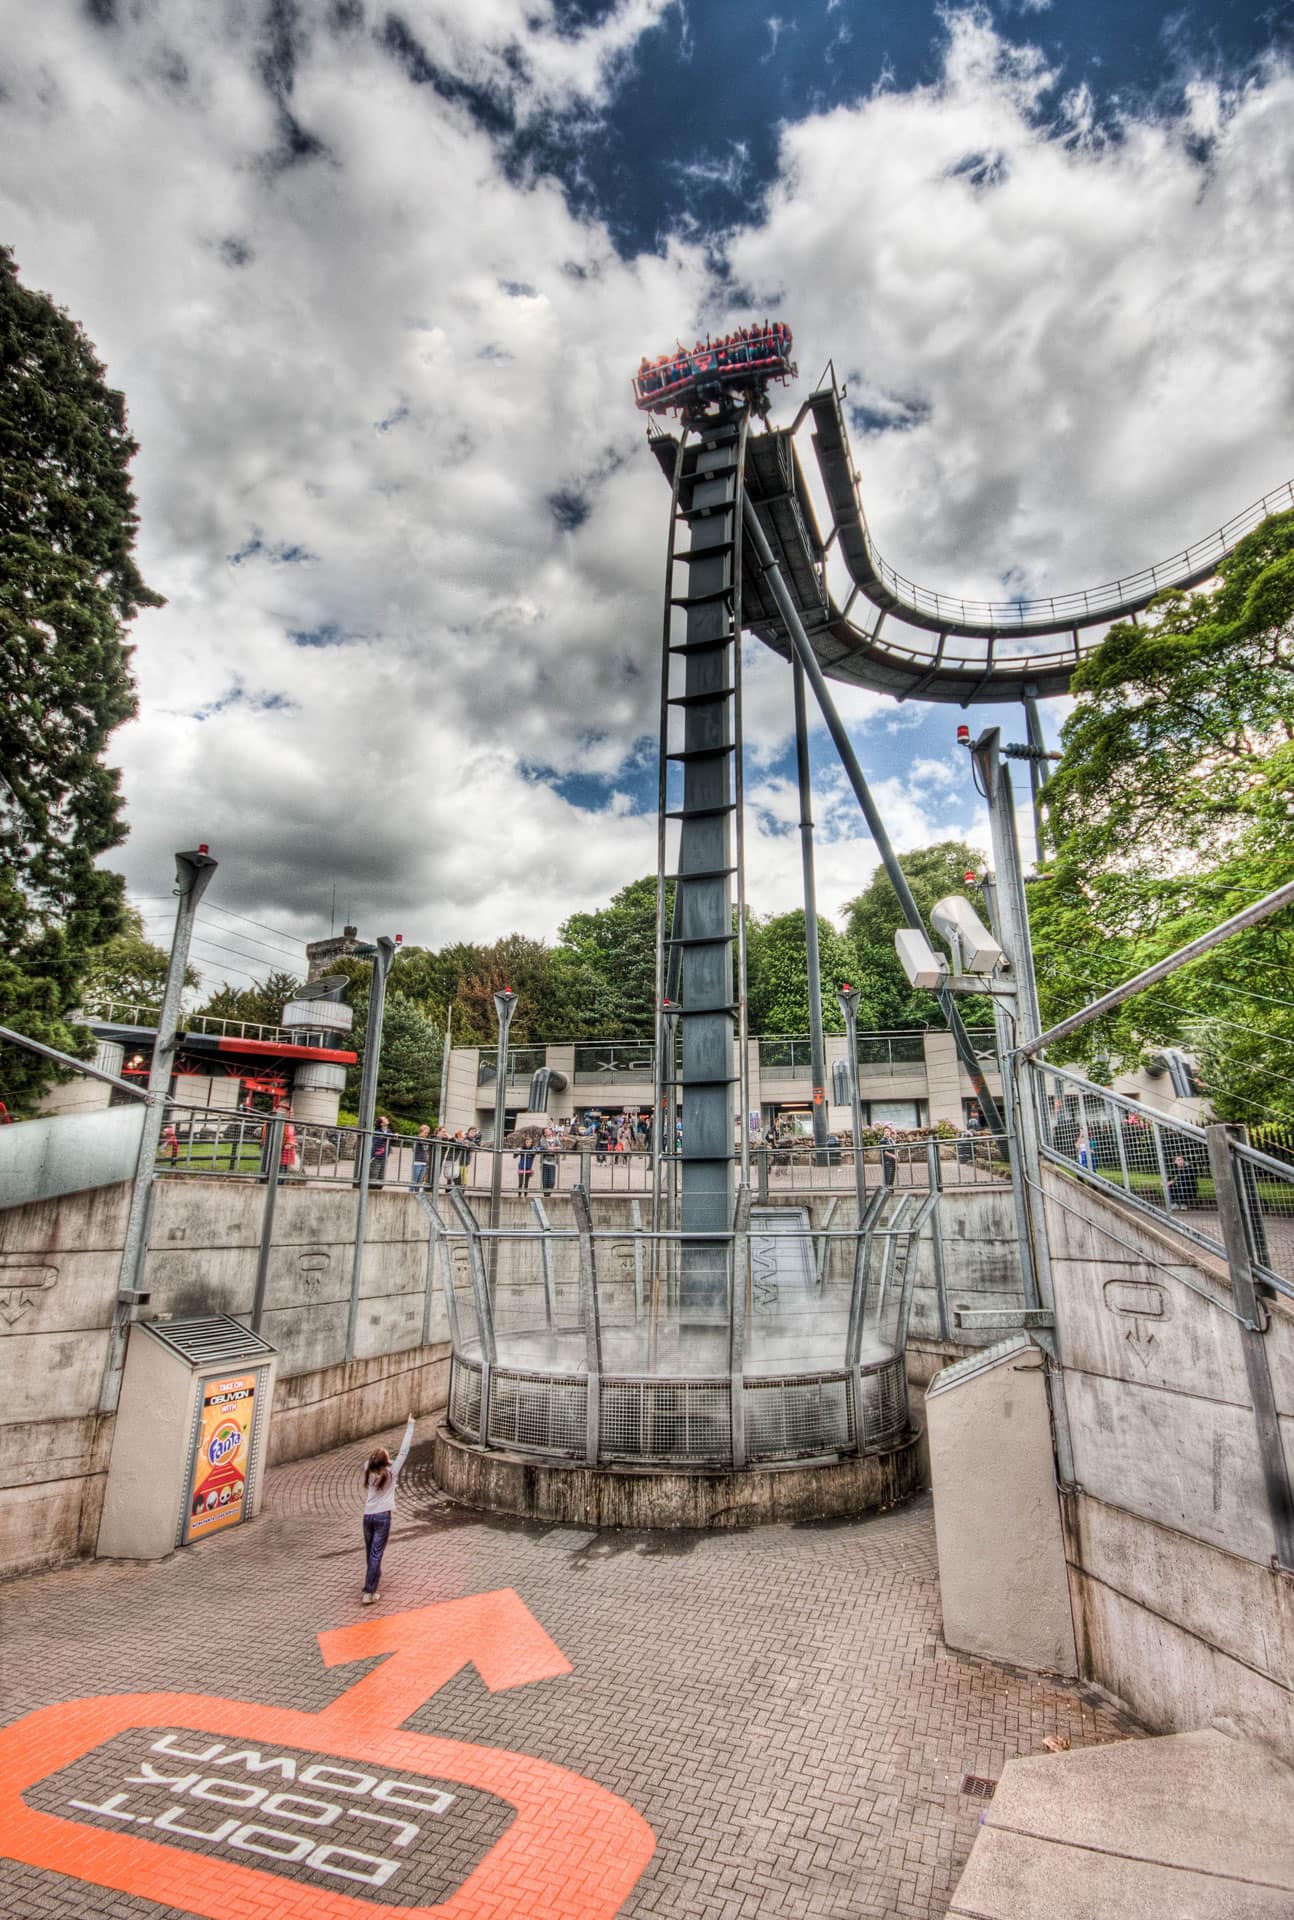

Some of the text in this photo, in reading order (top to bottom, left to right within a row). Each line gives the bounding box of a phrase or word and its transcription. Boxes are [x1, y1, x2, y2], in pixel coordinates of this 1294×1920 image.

[210, 1390, 249, 1405] OBLIVION
[209, 1431, 241, 1464] Fanta
[124, 1762, 420, 1847] LOOK
[150, 1734, 456, 1814] DOWN
[67, 1793, 402, 1886] DON'T
